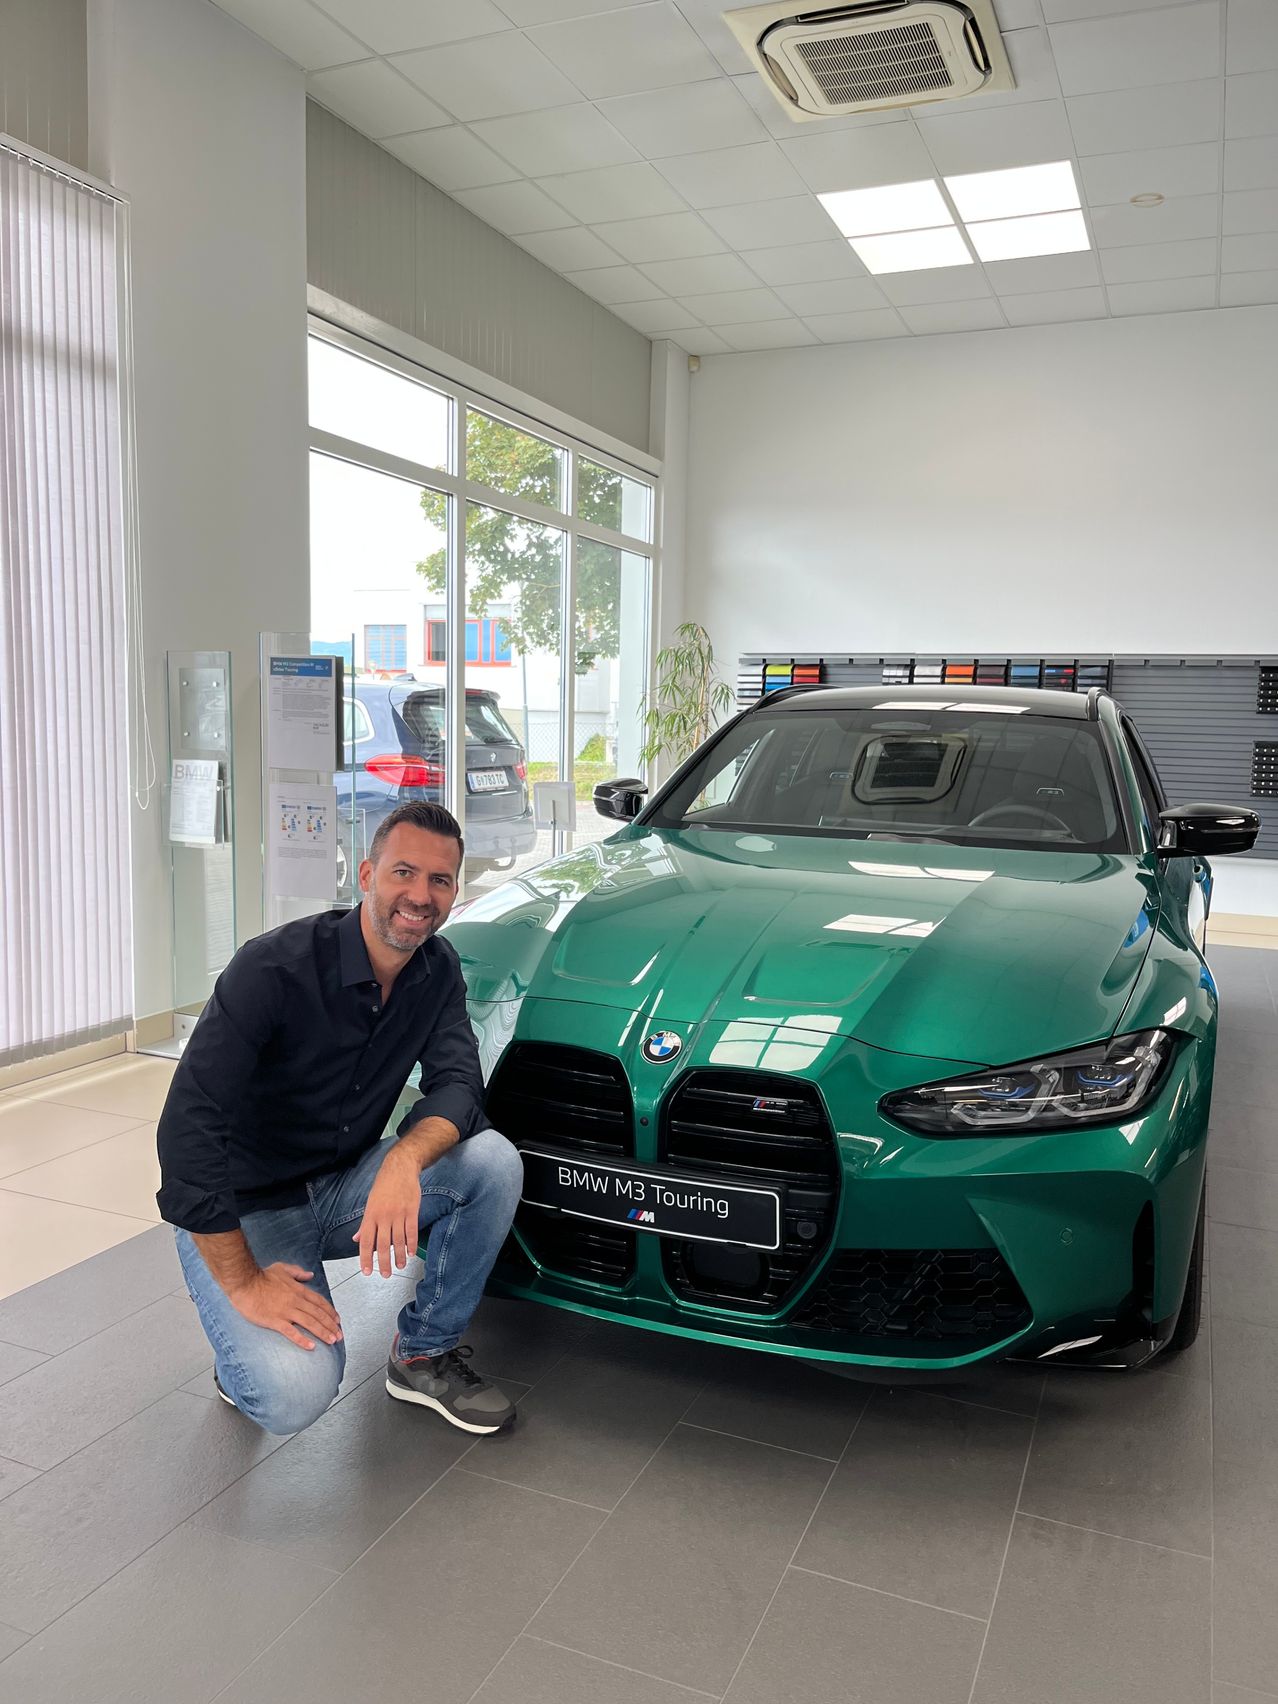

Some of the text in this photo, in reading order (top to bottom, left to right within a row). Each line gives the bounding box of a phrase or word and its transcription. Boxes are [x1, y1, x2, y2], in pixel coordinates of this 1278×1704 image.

[174, 764, 214, 779] BMW
[558, 1166, 729, 1219] BMW M3 Touring
